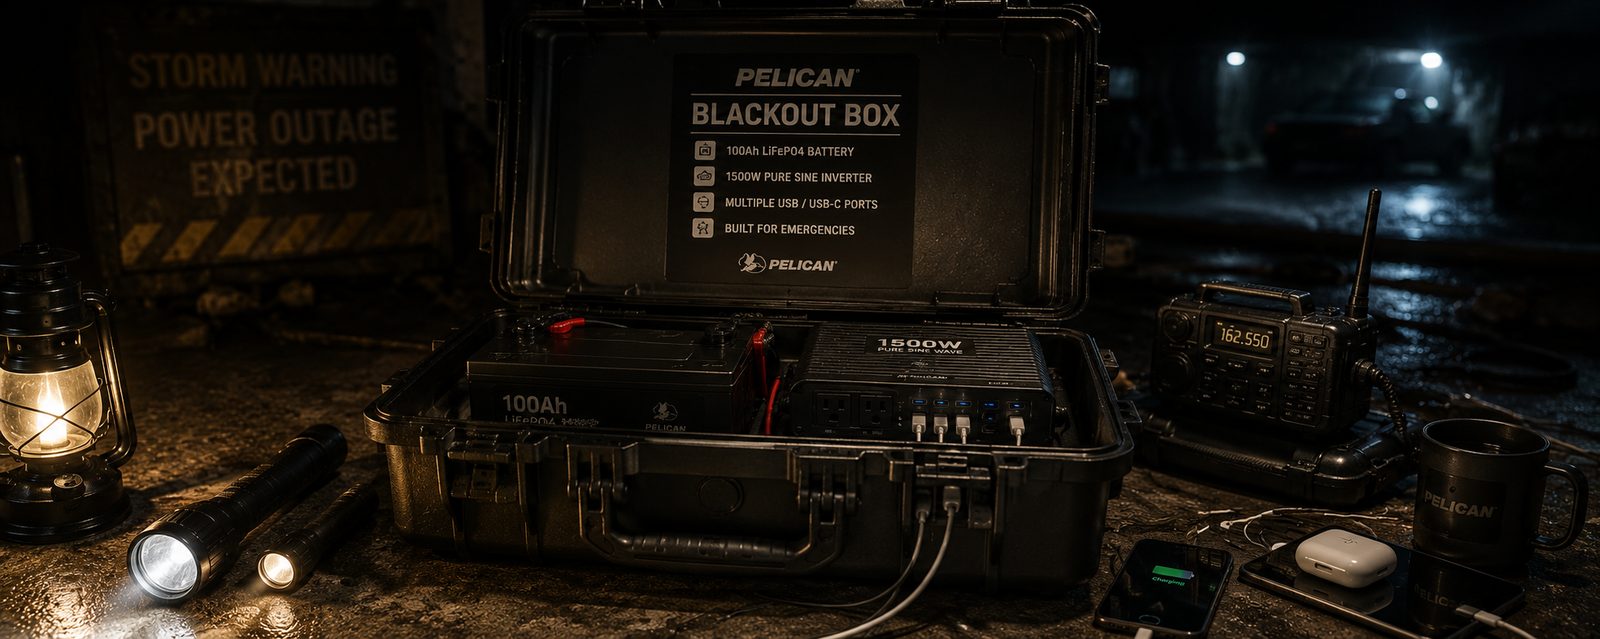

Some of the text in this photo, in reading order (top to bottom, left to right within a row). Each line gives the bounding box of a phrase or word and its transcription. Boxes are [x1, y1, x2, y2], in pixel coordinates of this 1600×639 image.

[129, 52, 398, 89] STORM WARNING
[735, 67, 855, 88] PELICAN
[691, 102, 900, 127] BLACKOUT BOX
[132, 105, 399, 150] POWER OUTAGE
[726, 145, 855, 157] 100Ah LiFePO4 BATTERY
[190, 154, 358, 198] EXPECTED
[725, 171, 873, 184] 1500W PURE SINE INVERTER
[725, 197, 878, 210] MULTIPLE USB / USB-C PORTS
[724, 223, 856, 236] BUILT FOR EMERGENCIES
[768, 259, 836, 272] PELICAN
[877, 338, 962, 349] 1500W
[1221, 328, 1270, 349] 162.550
[502, 394, 568, 415] 100Ah
[645, 423, 687, 432] PELICAN
[1425, 489, 1494, 519] PELICAN
